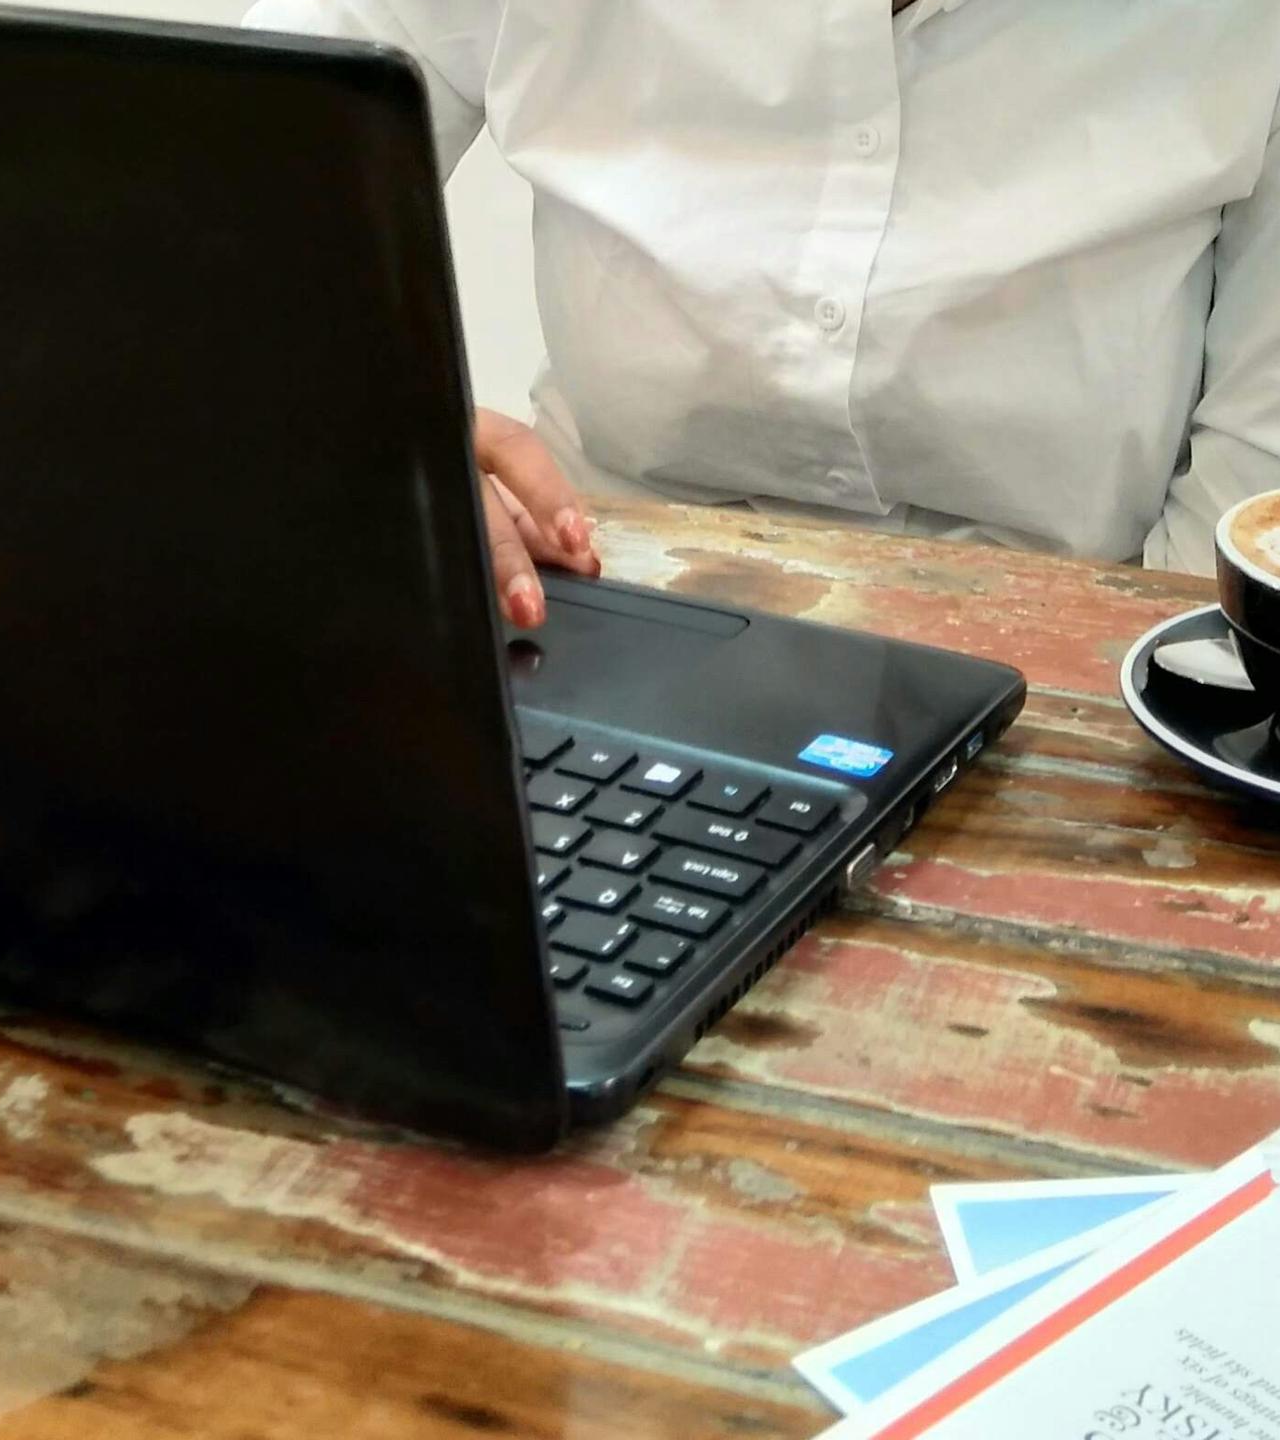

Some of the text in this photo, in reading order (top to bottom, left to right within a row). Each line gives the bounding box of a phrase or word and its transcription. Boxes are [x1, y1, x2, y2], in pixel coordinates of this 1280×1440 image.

[555, 793, 577, 808] X
[789, 800, 811, 814] Ctrl
[624, 811, 642, 826] Z
[707, 824, 733, 838] Shift
[553, 836, 571, 849] S
[621, 851, 639, 866] A
[682, 861, 740, 883] Caps Lock
[598, 889, 618, 905] Q
[687, 905, 710, 920] Tab
[1174, 1326, 1228, 1361] fields
[1177, 1354, 1209, 1375] six
[1222, 1358, 1255, 1379] ski
[1199, 1372, 1230, 1389] of
[1179, 1382, 1251, 1429] humble
